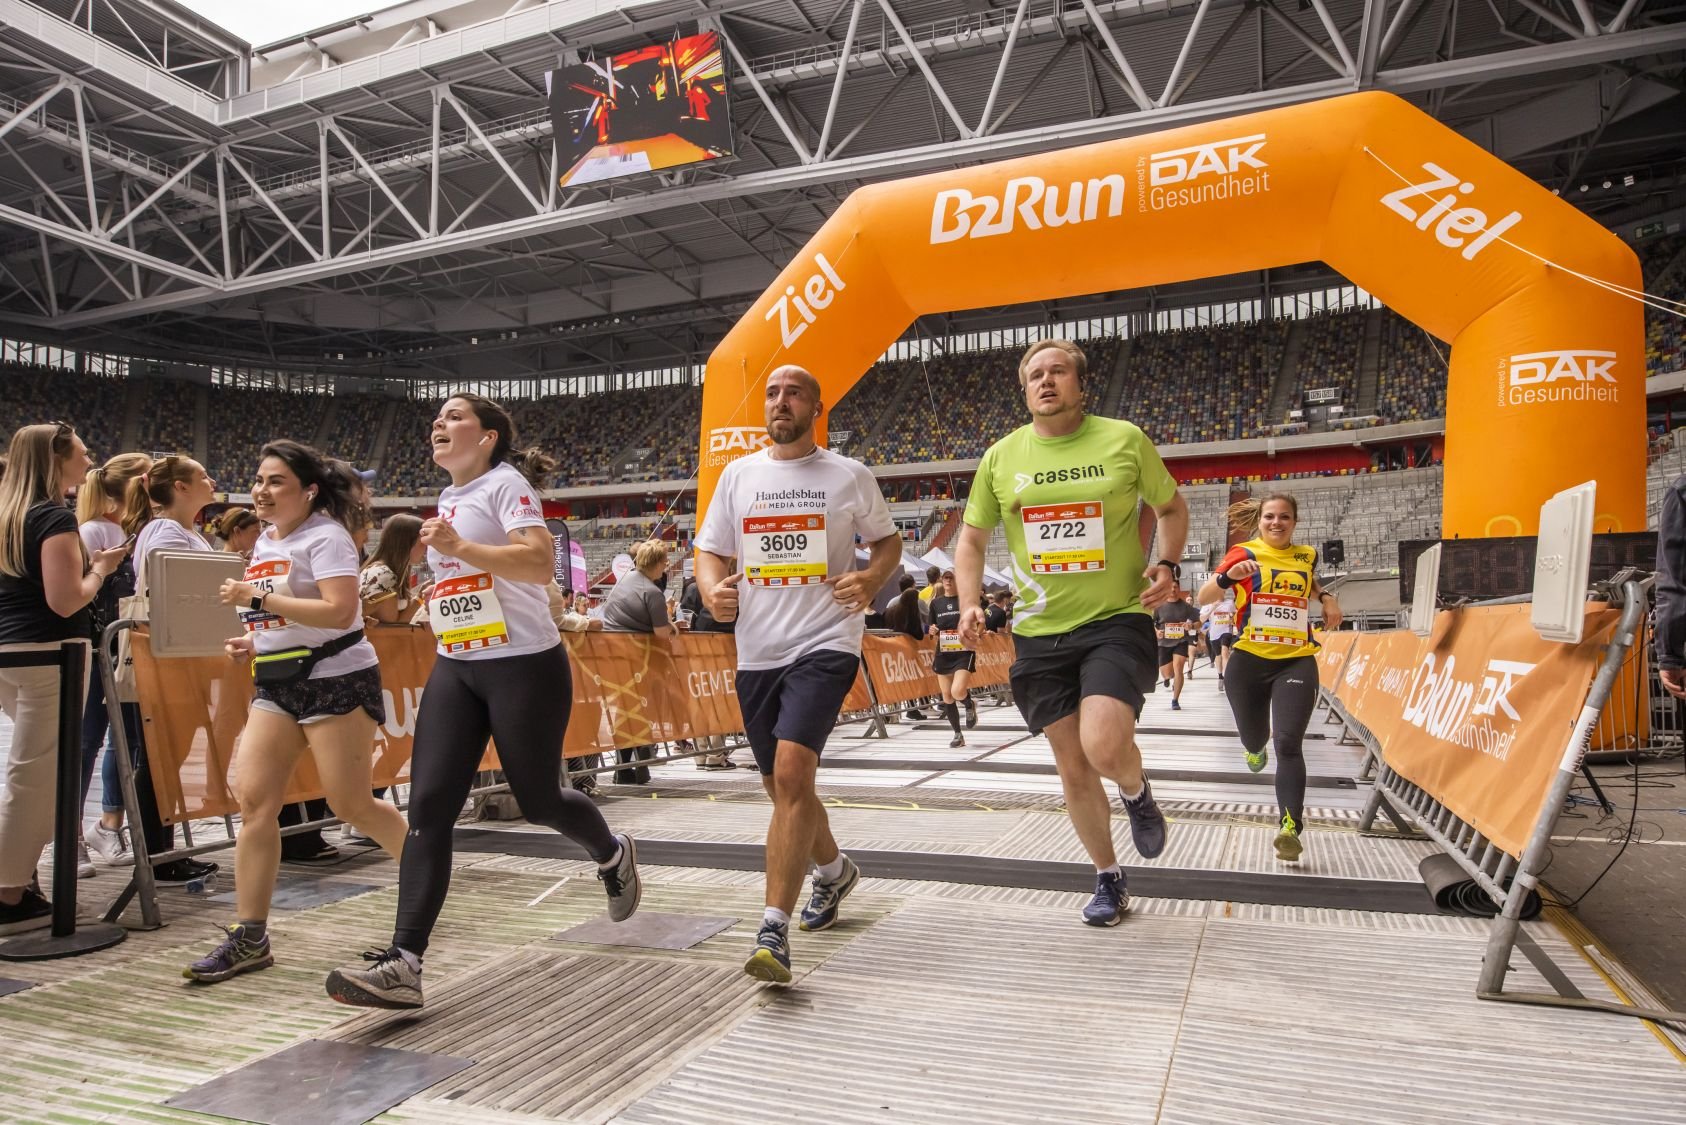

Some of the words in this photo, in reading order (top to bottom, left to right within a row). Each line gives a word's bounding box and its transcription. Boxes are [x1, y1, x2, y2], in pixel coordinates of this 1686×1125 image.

[1137, 155, 1146, 166] by
[1150, 133, 1269, 186] DAK
[1137, 168, 1146, 213] powered
[1150, 171, 1270, 211] Gesundheit
[929, 174, 1125, 245] B2Run
[1380, 162, 1522, 261] Ziel
[765, 252, 847, 349] Ziel
[1498, 358, 1507, 369] by
[1510, 350, 1617, 385] DAK
[1498, 370, 1506, 407] powered
[1509, 381, 1618, 405] Gesundheit
[1034, 464, 1105, 485] cassini
[756, 488, 826, 501] Handelsblatt
[1040, 522, 1086, 540] 2722
[760, 534, 808, 552] 3609
[440, 594, 483, 617] 6029
[1265, 606, 1298, 621] 4553
[454, 615, 475, 623] CELINE
